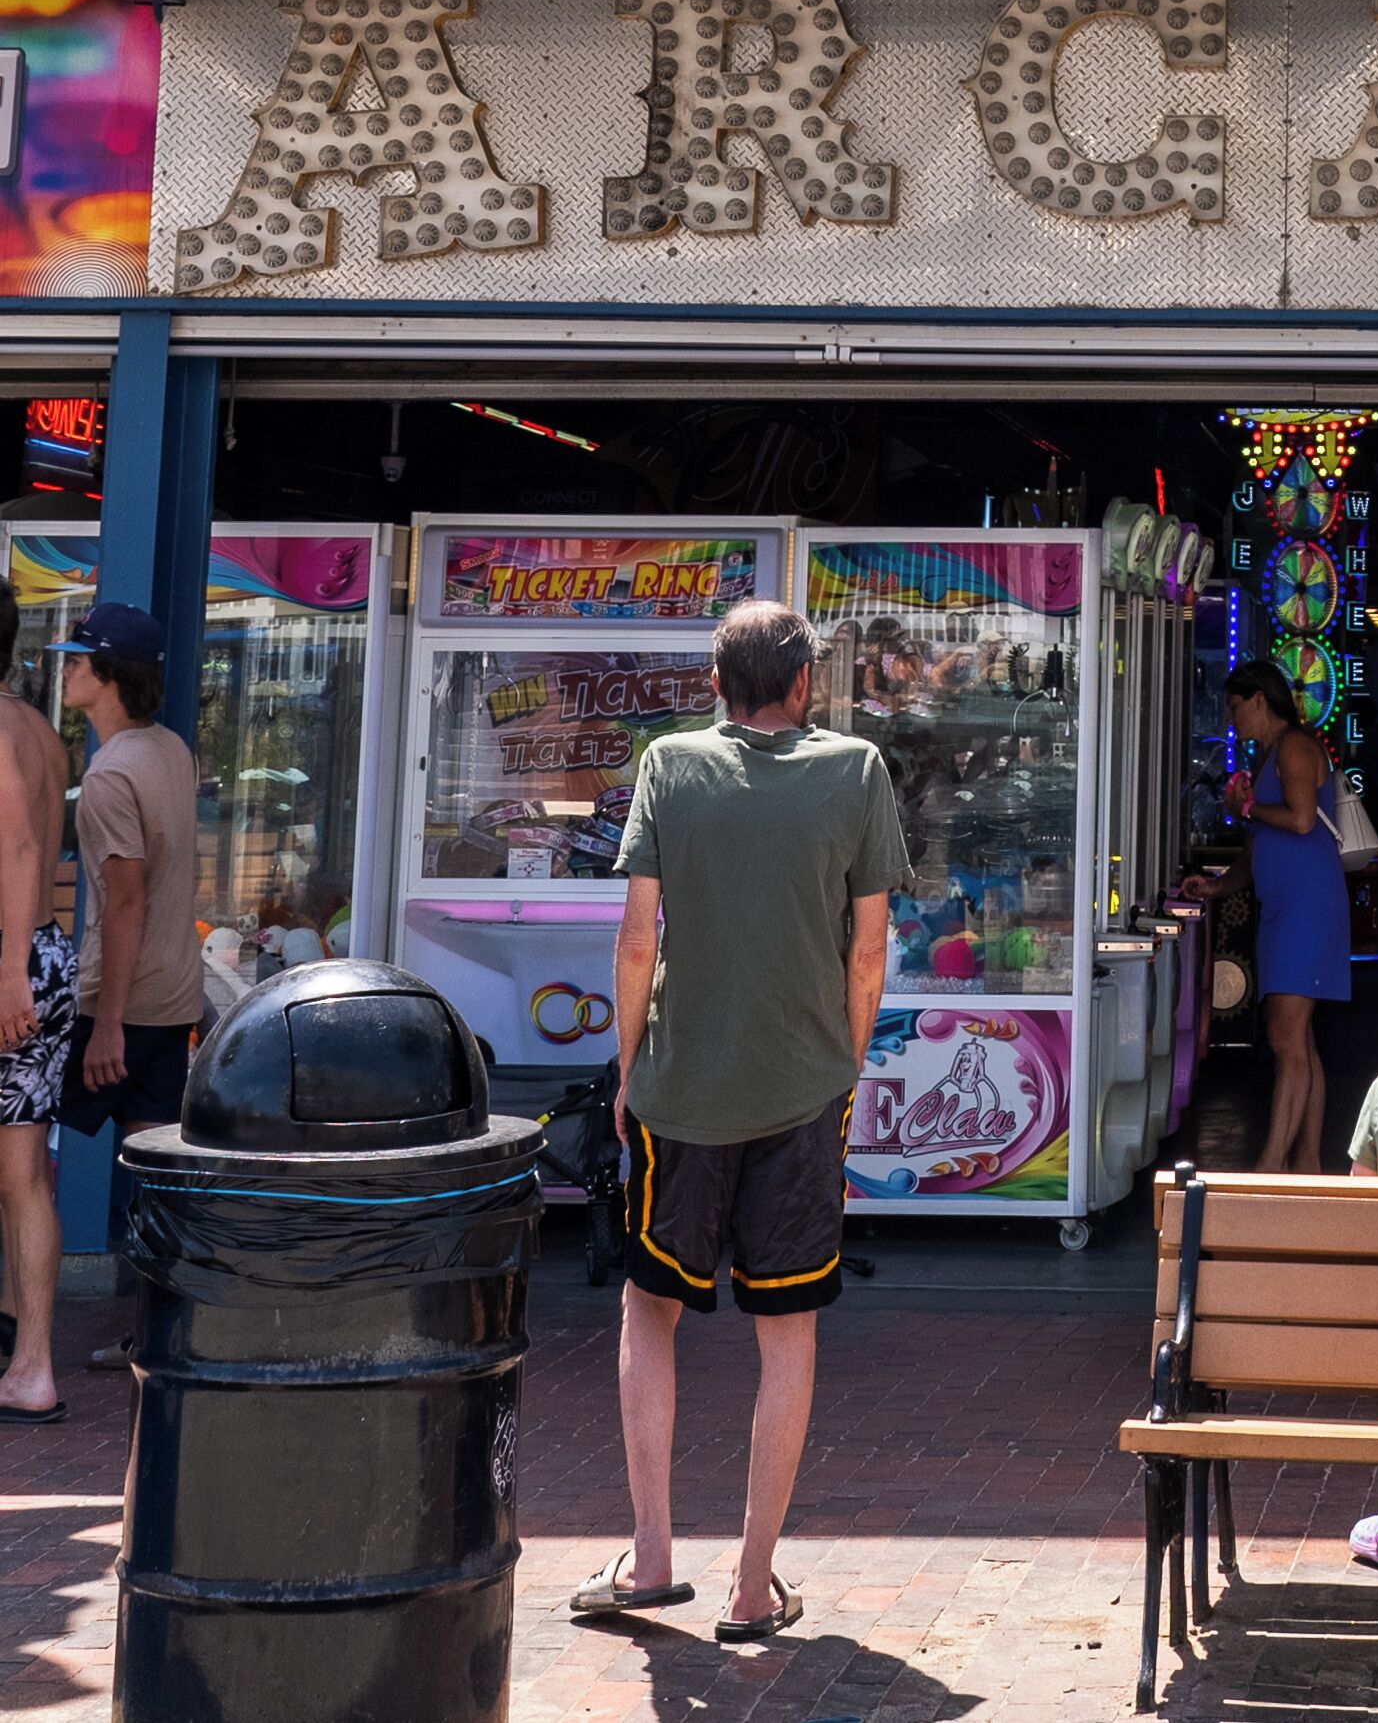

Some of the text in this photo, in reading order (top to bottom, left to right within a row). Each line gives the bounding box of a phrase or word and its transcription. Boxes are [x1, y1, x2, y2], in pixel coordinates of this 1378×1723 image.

[488, 559, 721, 604] TICKET RING
[488, 663, 717, 725] WIN TICKETS
[500, 728, 632, 775] TICKETS
